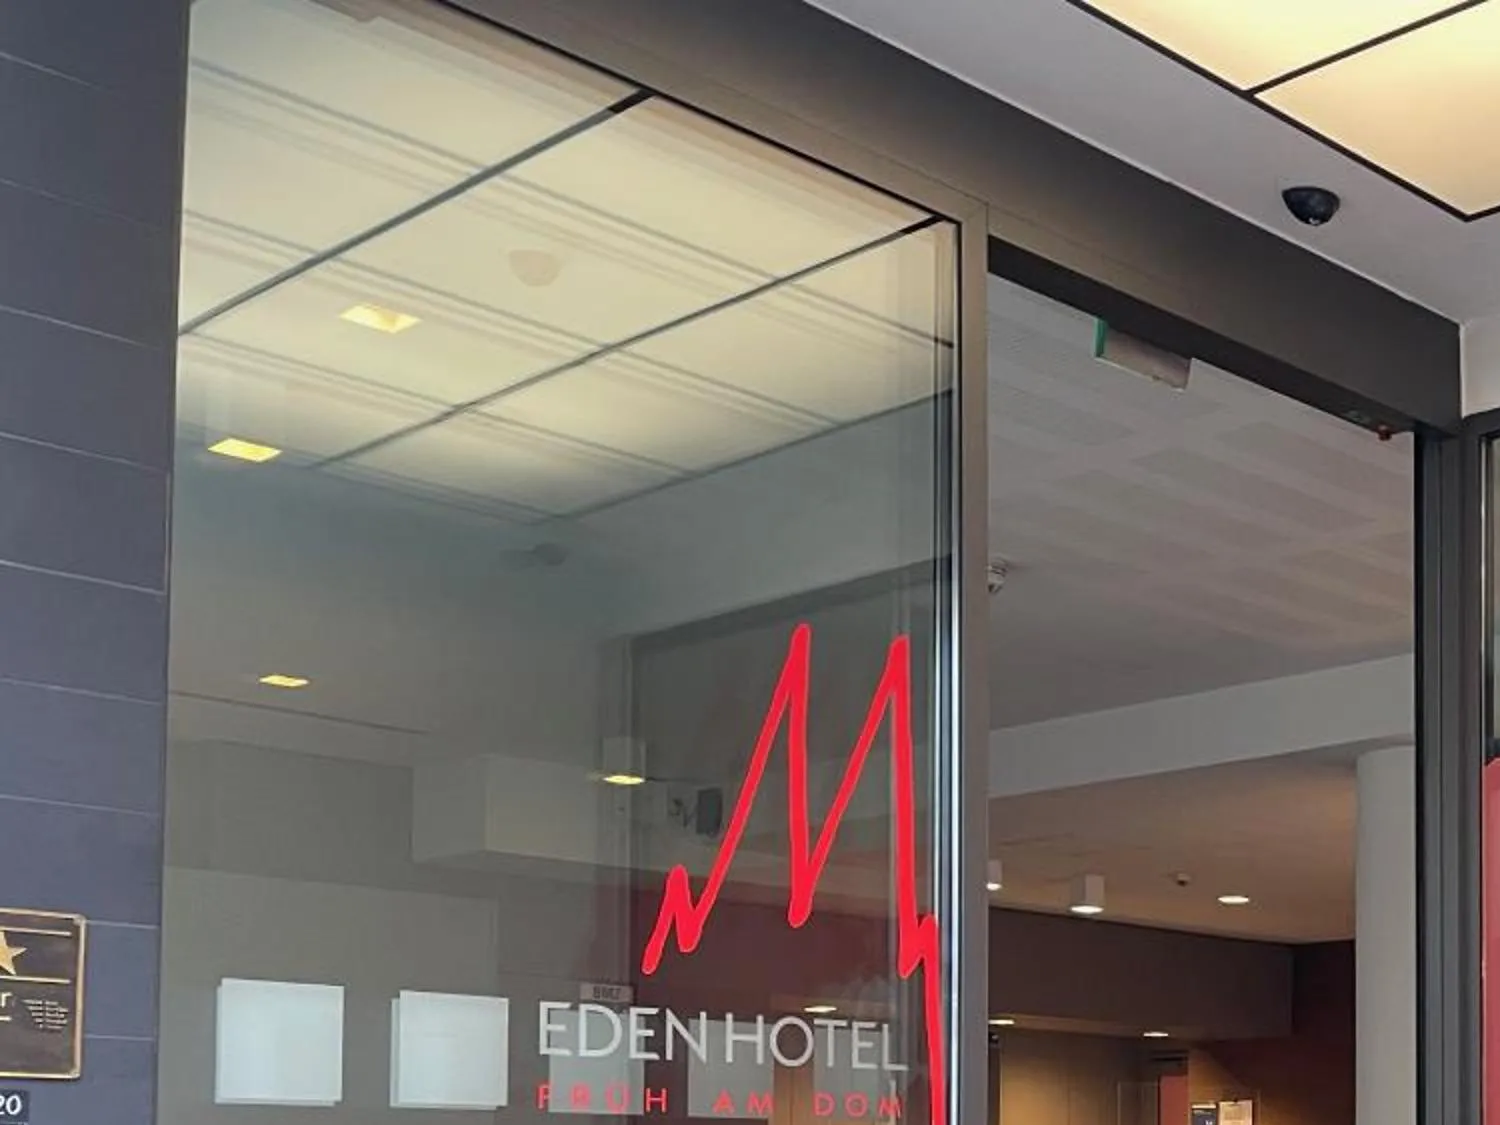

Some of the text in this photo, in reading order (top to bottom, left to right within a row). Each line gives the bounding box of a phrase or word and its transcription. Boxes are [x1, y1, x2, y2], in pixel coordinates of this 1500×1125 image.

[538, 1001, 909, 1072] EDEN HOTEL
[536, 1079, 904, 1118] FRÜH AM DOM
